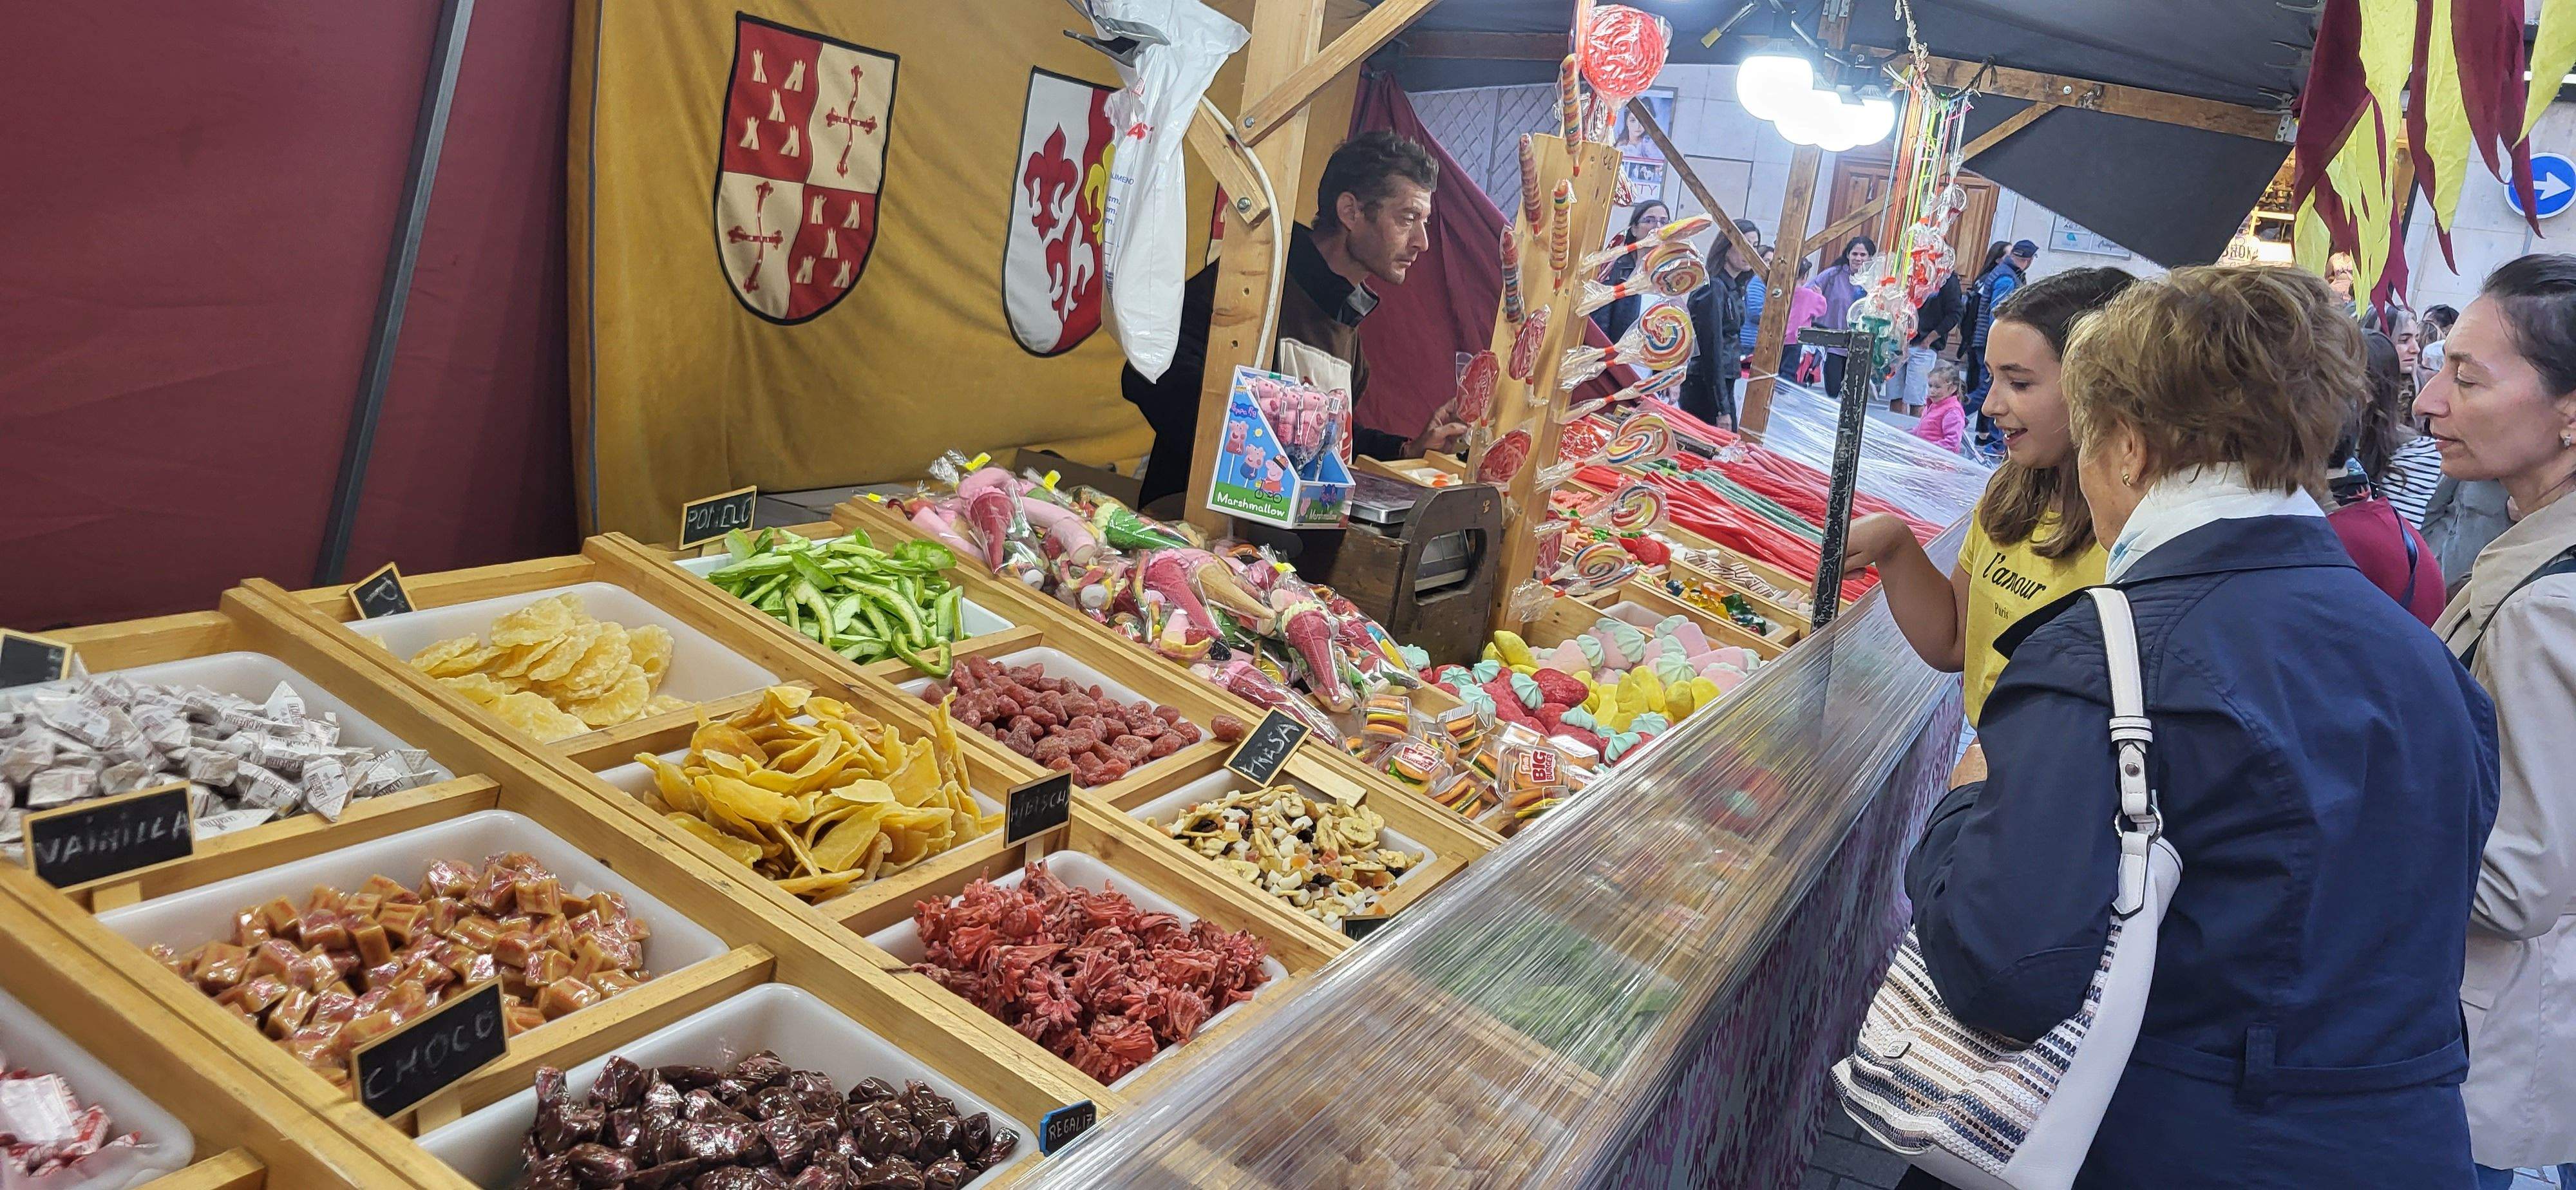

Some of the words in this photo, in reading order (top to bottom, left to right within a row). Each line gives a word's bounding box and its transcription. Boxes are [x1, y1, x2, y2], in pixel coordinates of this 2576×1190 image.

[1217, 491, 1285, 517] Marshmallow
[1533, 751, 1546, 780] BIG
[365, 1010, 495, 1099] CHOCO
